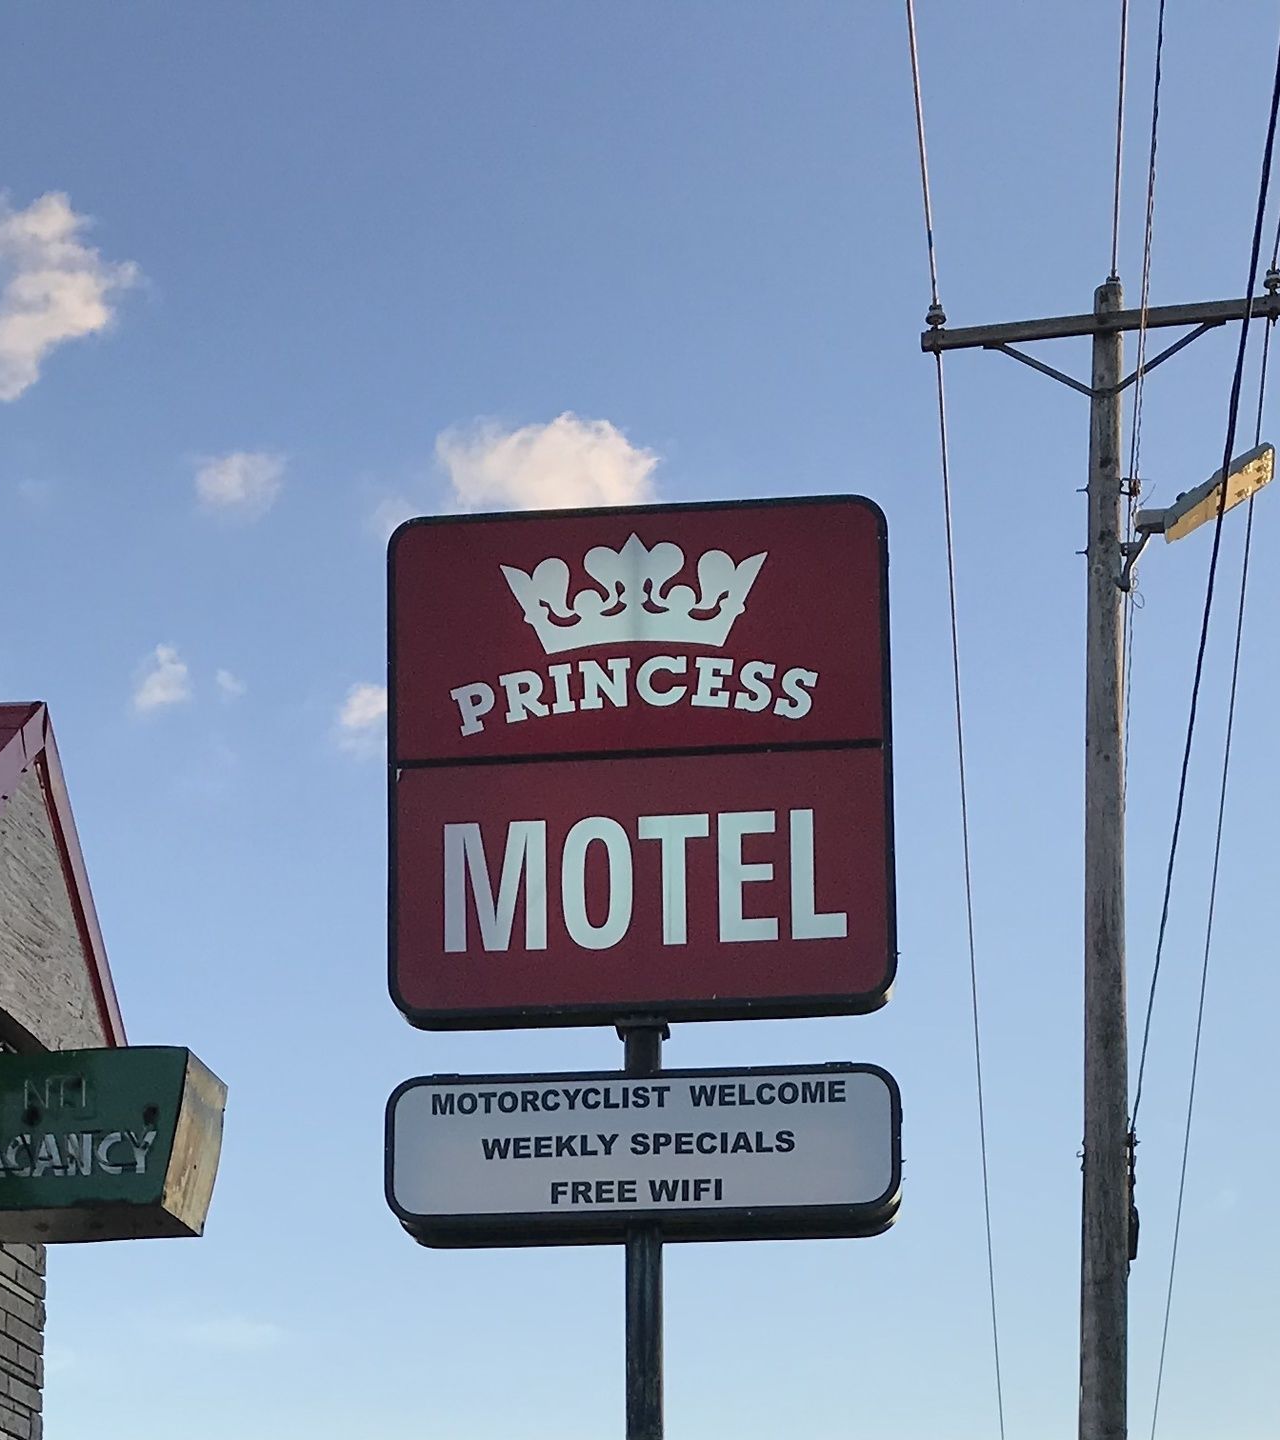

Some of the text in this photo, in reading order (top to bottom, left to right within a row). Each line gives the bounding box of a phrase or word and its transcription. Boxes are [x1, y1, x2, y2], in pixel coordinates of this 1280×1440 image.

[450, 656, 818, 736] PRINCESS
[443, 808, 847, 953] MOTEL
[431, 1081, 847, 1115] MOTORCYCLIST WELCOME
[481, 1130, 796, 1160] WEEKLY SPECIALS
[550, 1178, 723, 1204] FREE WIFI
